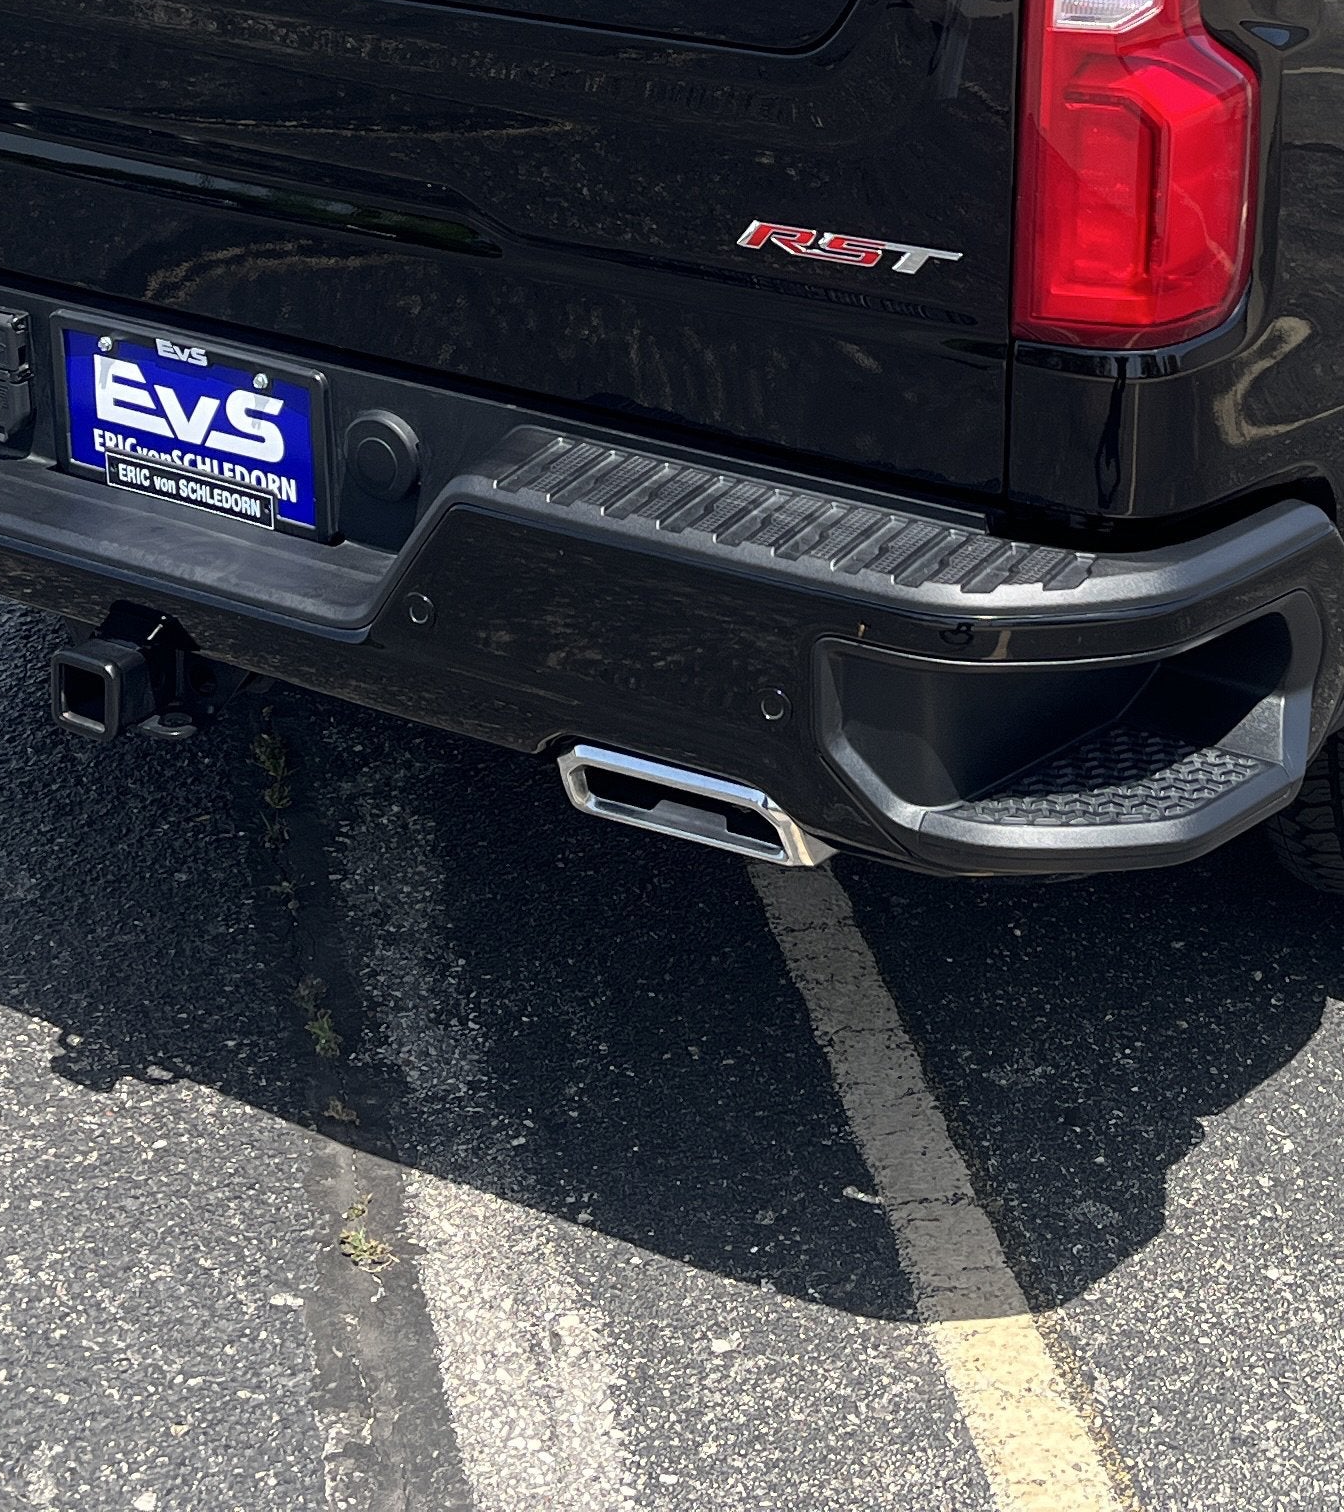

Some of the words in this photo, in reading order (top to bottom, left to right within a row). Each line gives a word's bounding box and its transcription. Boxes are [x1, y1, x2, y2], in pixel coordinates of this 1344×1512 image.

[736, 219, 964, 275] RST
[118, 463, 151, 487] ERIC
[153, 475, 177, 495] von
[179, 478, 262, 519] SCHLEDORN
